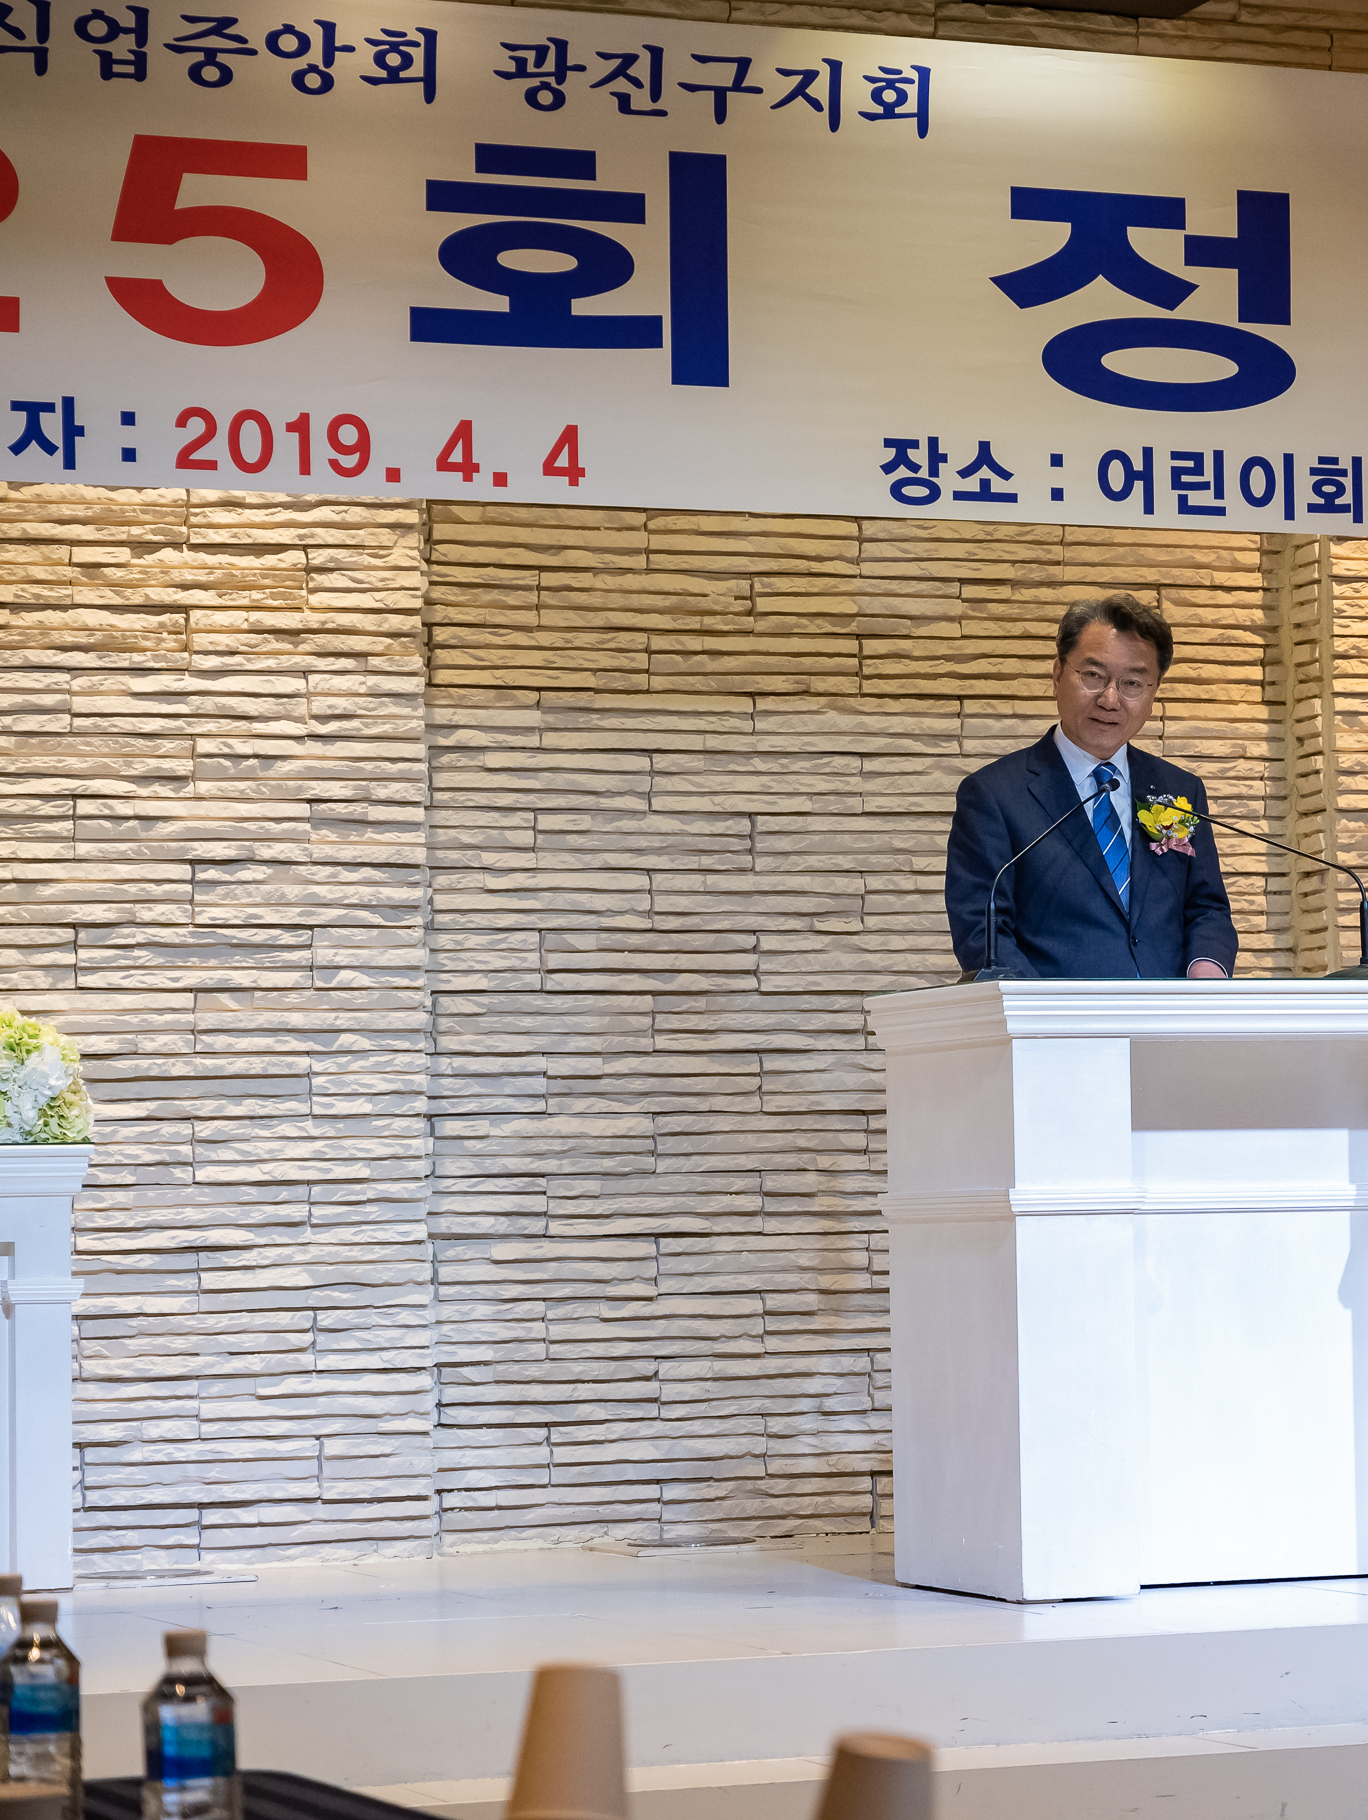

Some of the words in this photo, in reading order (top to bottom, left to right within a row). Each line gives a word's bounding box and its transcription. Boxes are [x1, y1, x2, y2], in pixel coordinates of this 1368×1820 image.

[0, 0, 438, 105] 식업중앙회
[493, 36, 932, 140] 광진구지회
[175, 406, 401, 483] 2019.
[542, 424, 587, 487] 4
[879, 436, 1018, 507] 장소
